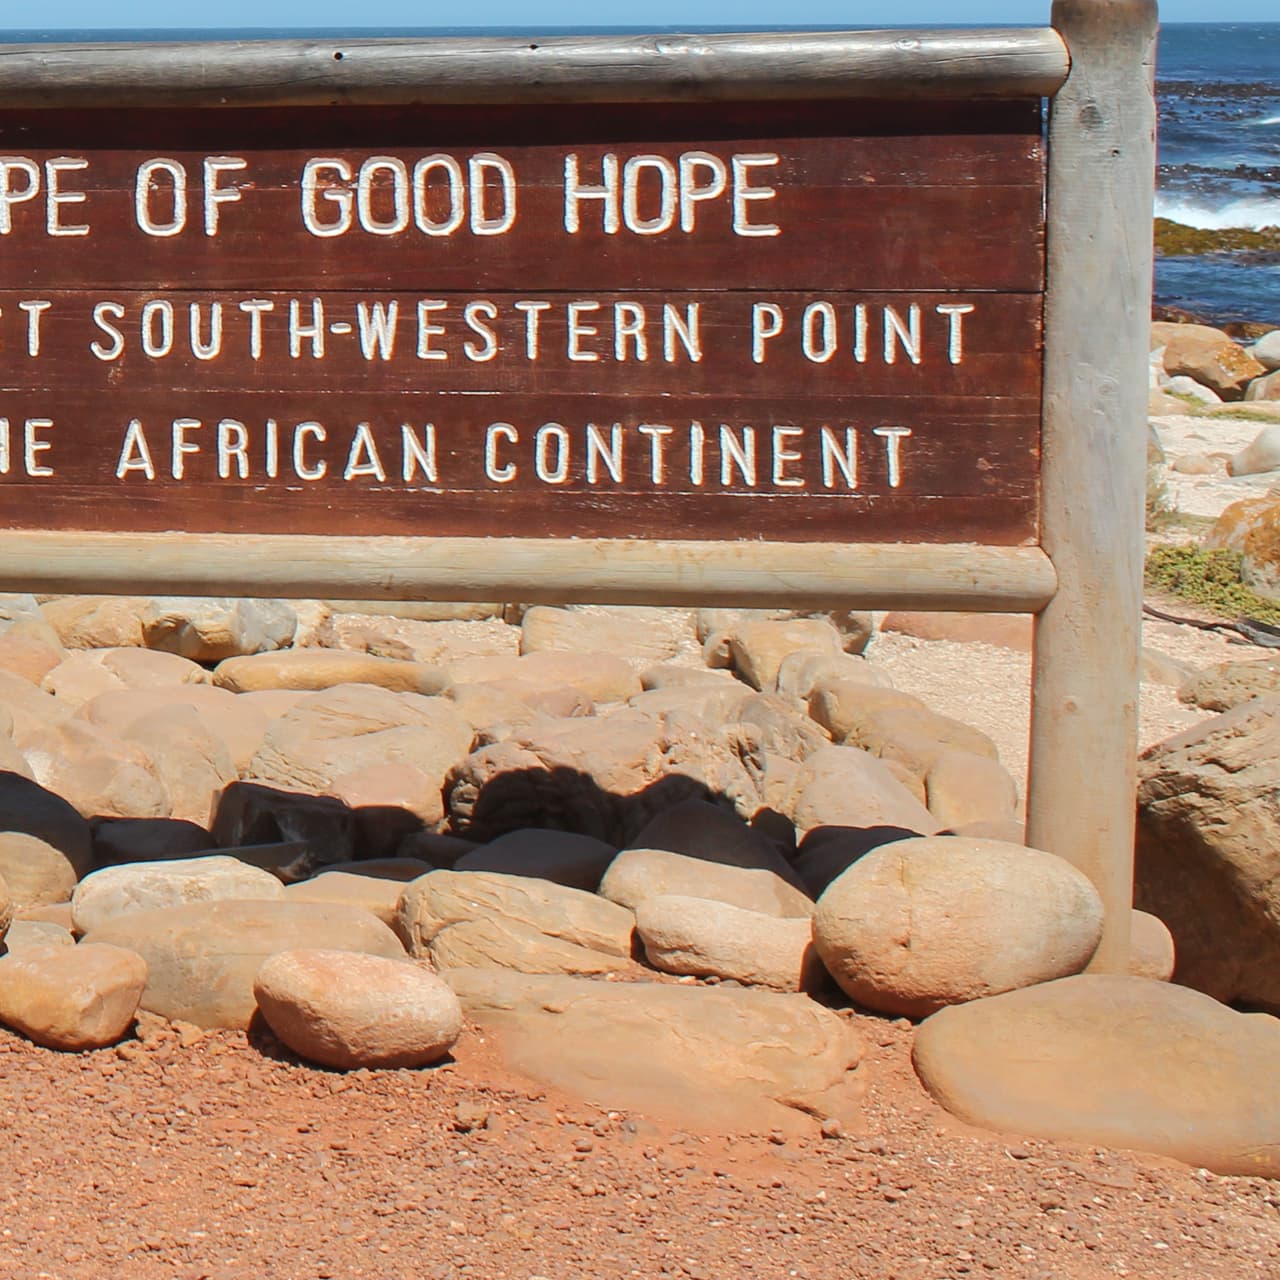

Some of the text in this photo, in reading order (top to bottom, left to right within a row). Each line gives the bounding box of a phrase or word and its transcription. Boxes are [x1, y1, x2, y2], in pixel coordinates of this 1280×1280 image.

[134, 154, 249, 238] OF
[299, 151, 517, 239] GOOD
[563, 149, 782, 238] HOPE
[89, 296, 704, 364] SOUTH-WESTERN
[751, 299, 976, 366] POINT
[114, 416, 439, 484] AFRICAN
[484, 419, 913, 491] CONTINENT
